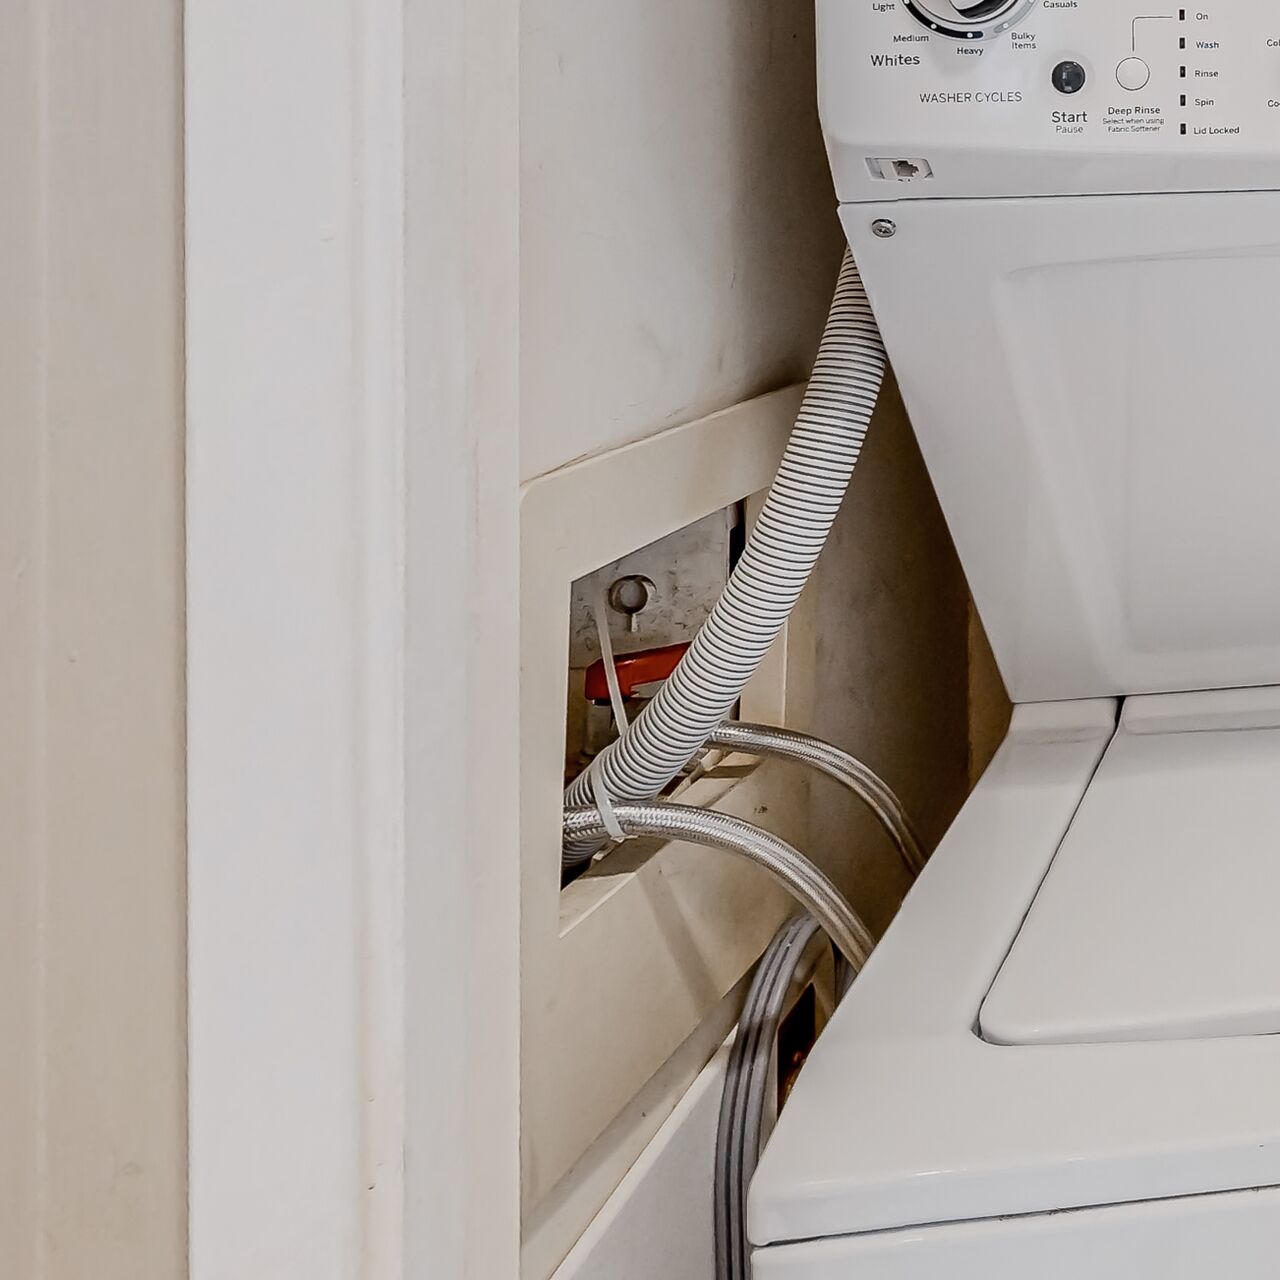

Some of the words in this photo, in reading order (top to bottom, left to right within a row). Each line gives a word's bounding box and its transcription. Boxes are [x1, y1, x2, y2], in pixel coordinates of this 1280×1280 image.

[872, 3, 895, 12] Light
[1043, 0, 1078, 8] Casuals
[893, 34, 929, 43] Medium
[1011, 33, 1035, 41] Bulky
[1012, 42, 1036, 50] Items
[1196, 41, 1219, 49] Wash
[956, 47, 984, 56] Heavy
[871, 55, 920, 67] Whites
[920, 93, 972, 103] WASHER
[975, 92, 1022, 102] CYCLES
[1194, 98, 1214, 107] Spin
[1108, 107, 1132, 116] Deep
[1134, 106, 1160, 114] Rinse
[1051, 111, 1088, 123] Start
[1055, 126, 1084, 134] Pause
[1194, 126, 1206, 135] Lid
[1209, 126, 1240, 134] Locked
